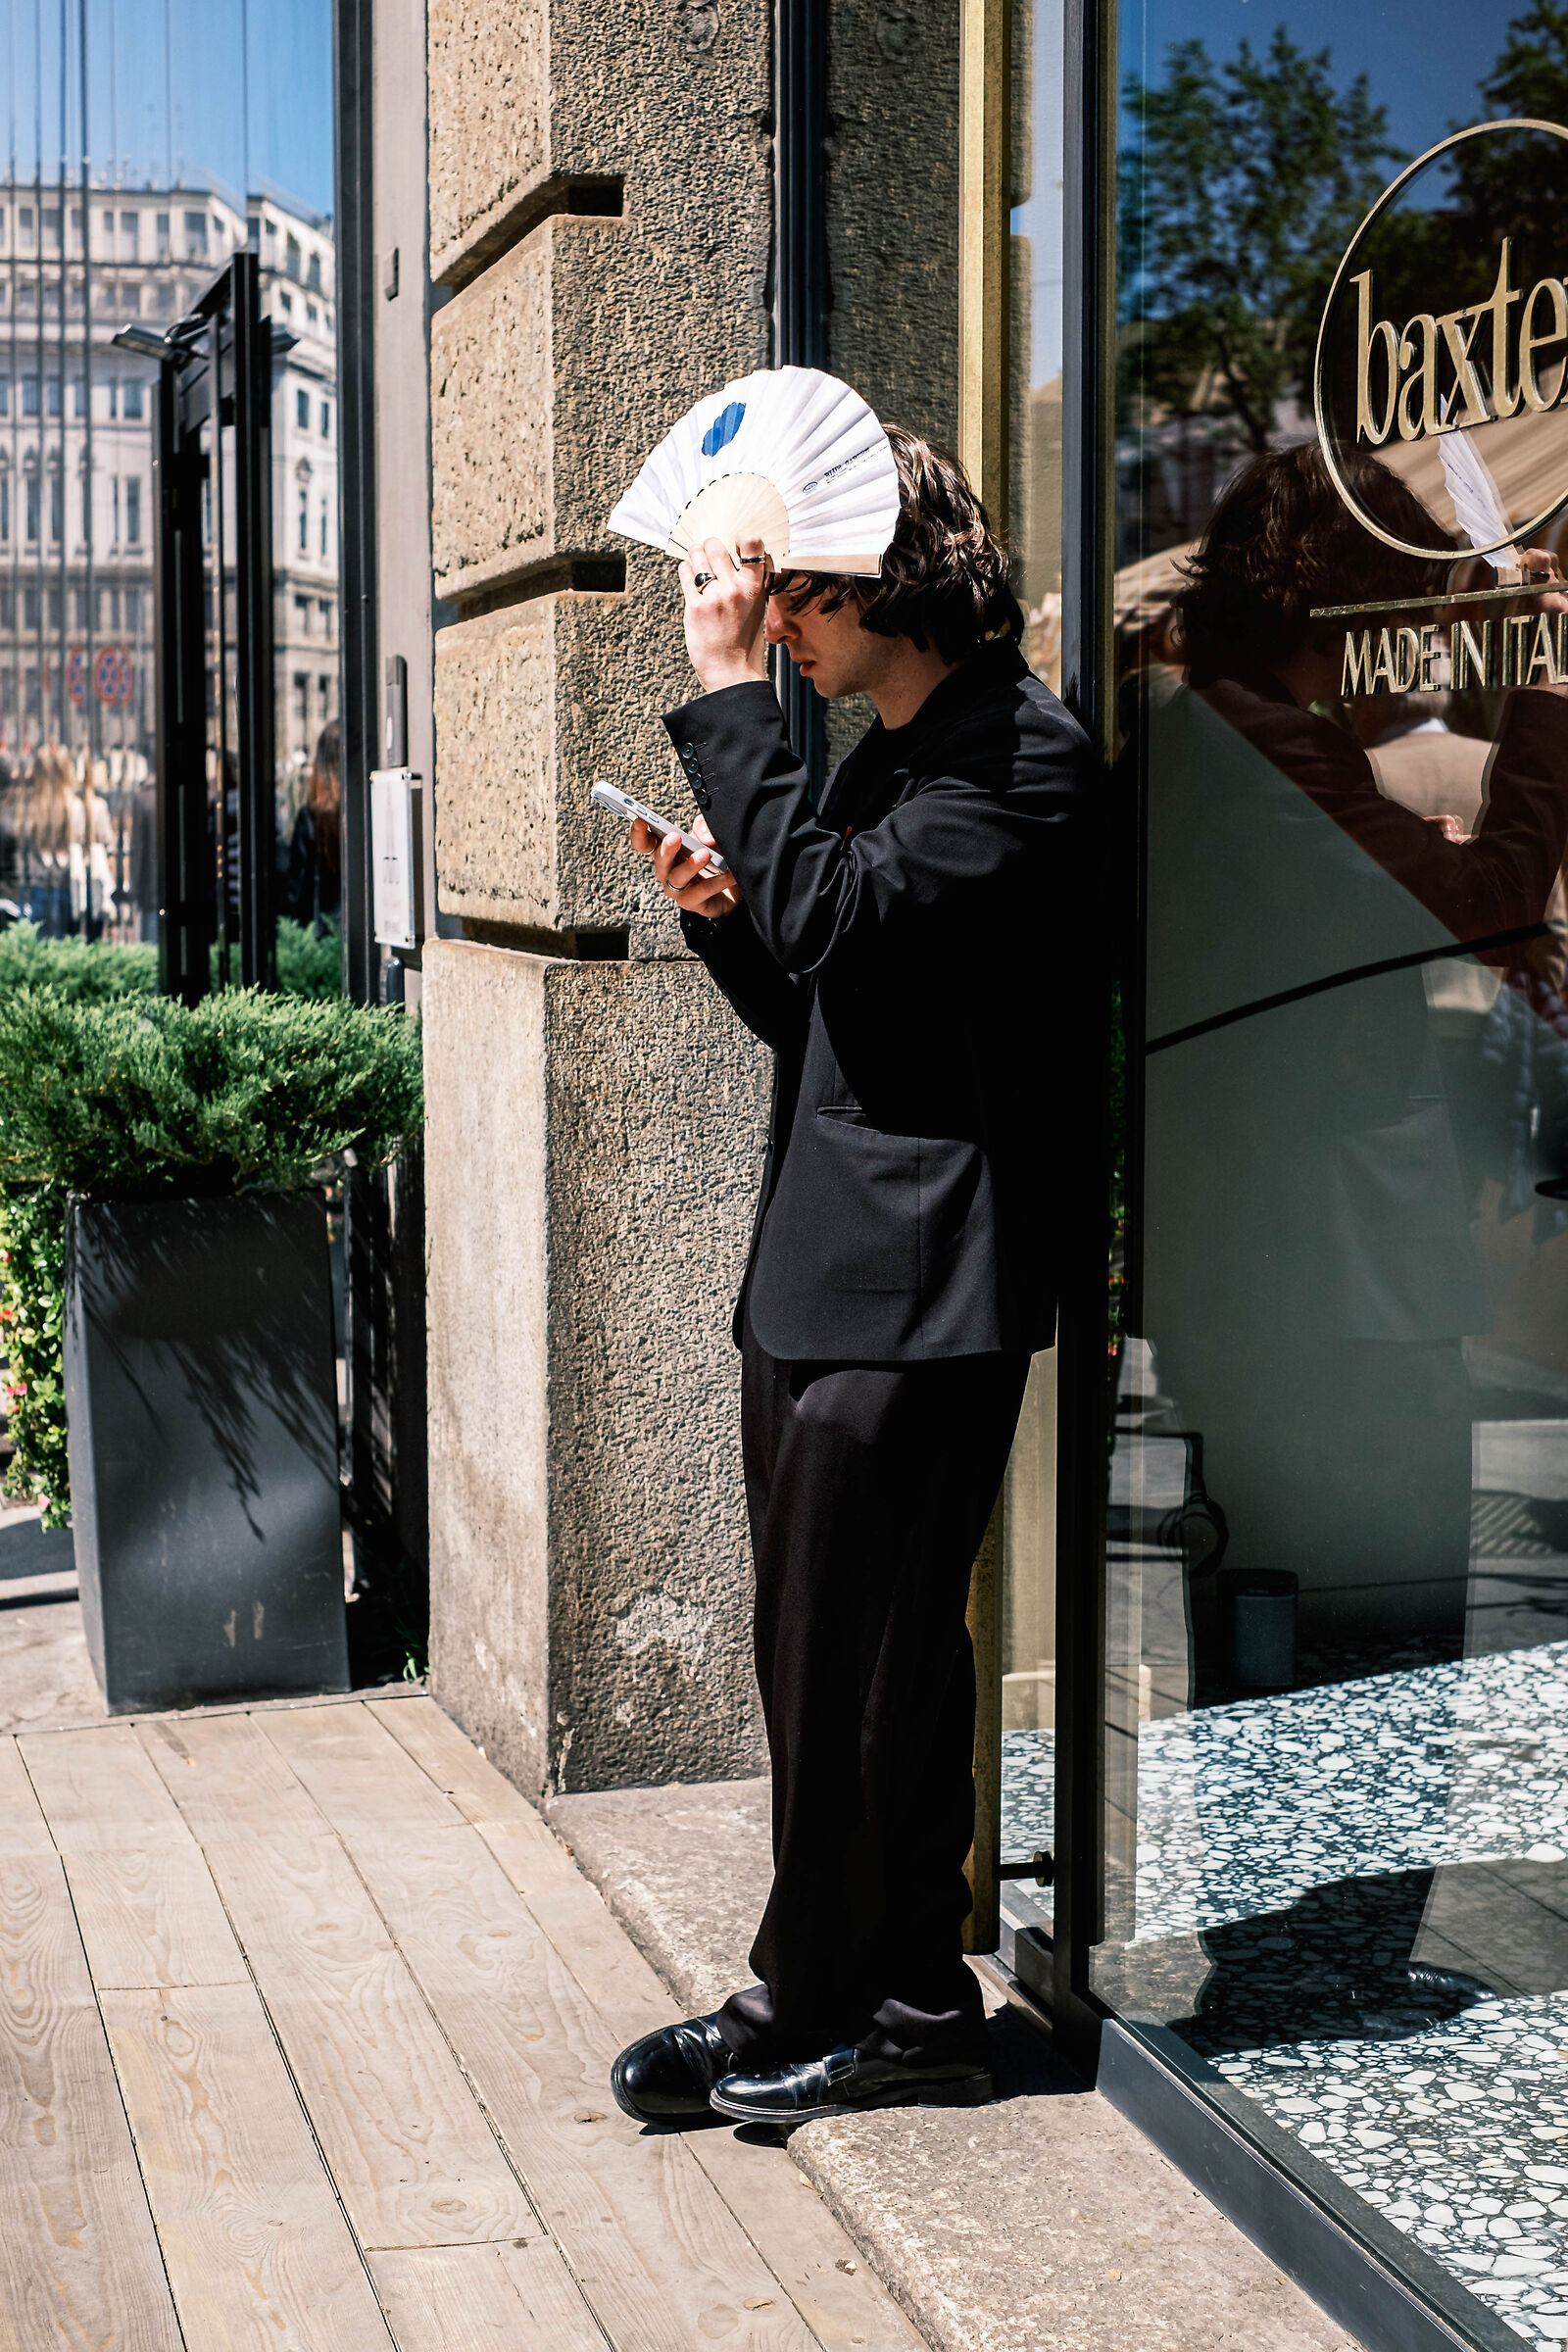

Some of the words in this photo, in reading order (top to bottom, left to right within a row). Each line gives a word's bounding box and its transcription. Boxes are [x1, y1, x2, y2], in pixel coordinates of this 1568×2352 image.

[1349, 236, 1568, 445] baxte
[1341, 624, 1443, 697] MADE
[1450, 619, 1494, 690] IN
